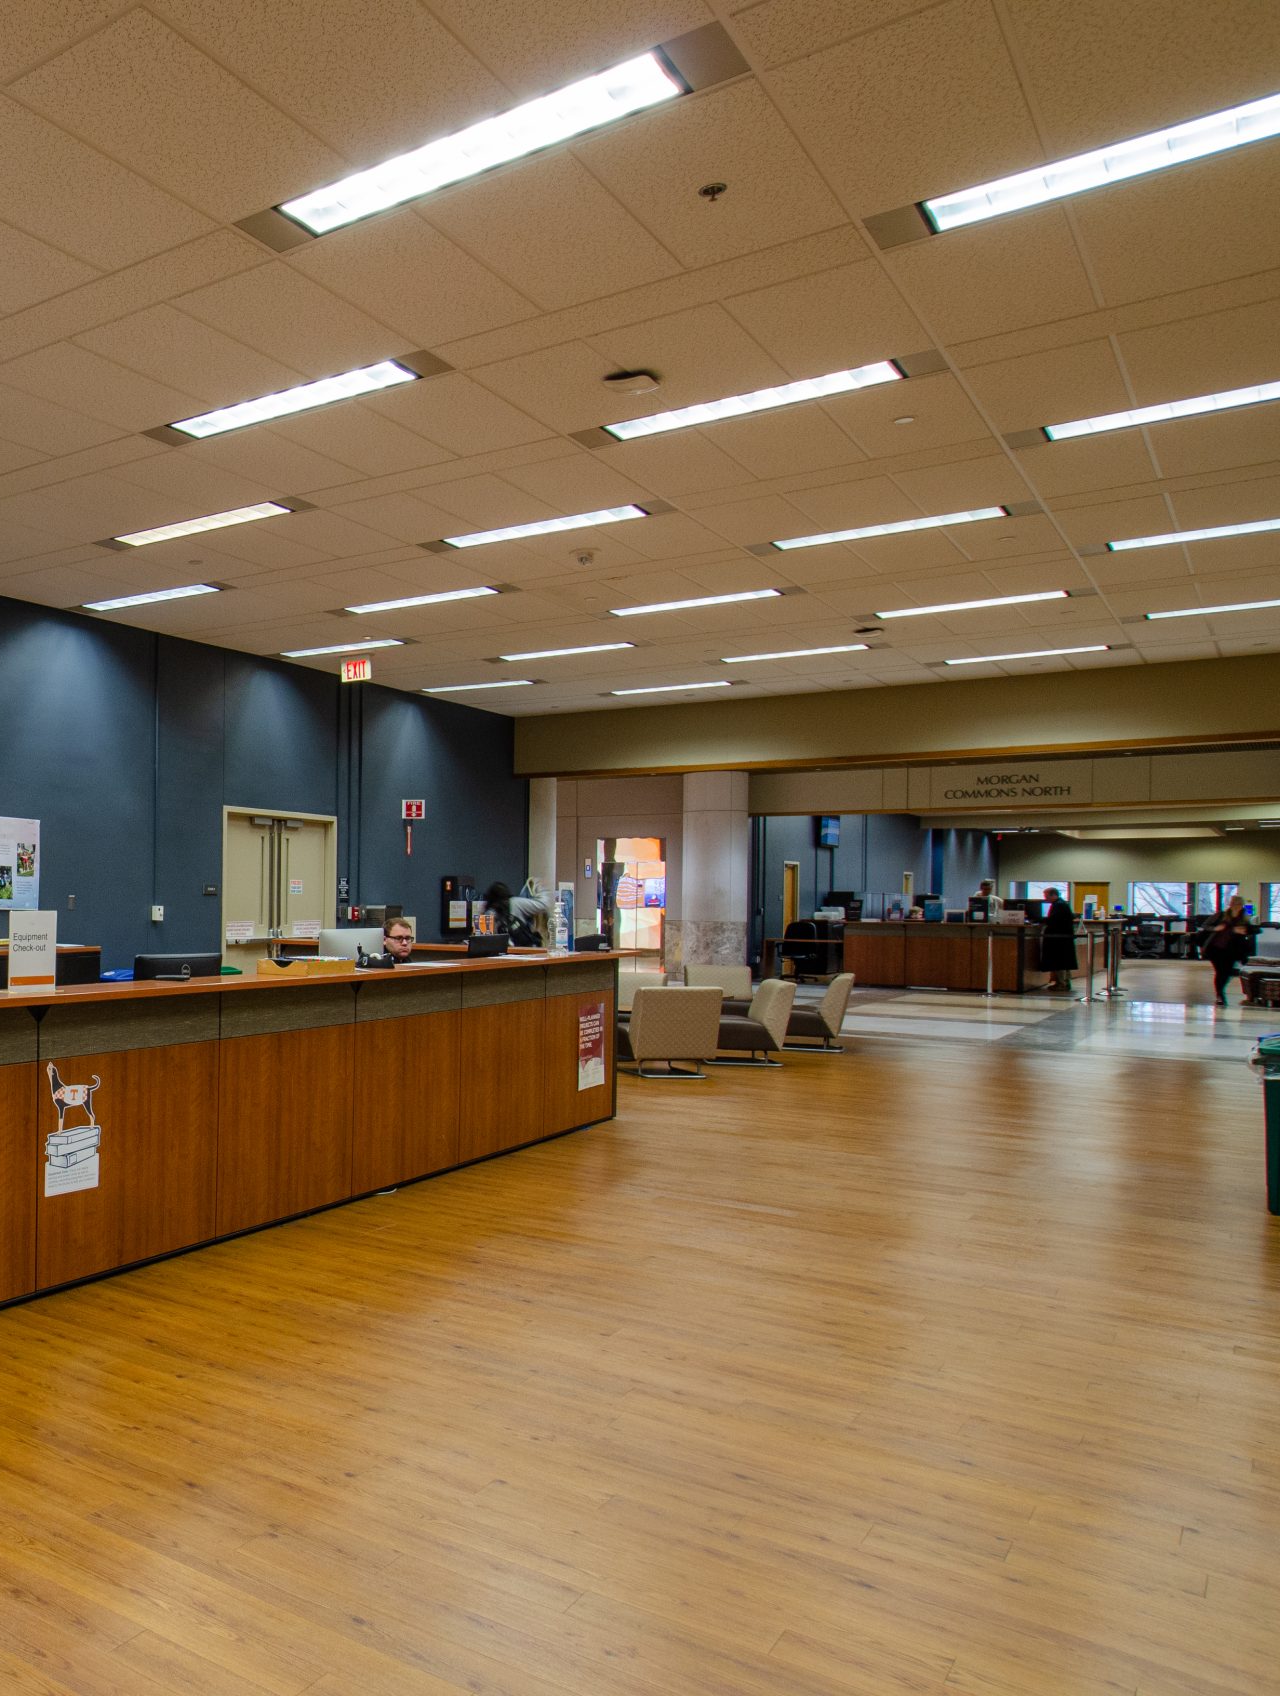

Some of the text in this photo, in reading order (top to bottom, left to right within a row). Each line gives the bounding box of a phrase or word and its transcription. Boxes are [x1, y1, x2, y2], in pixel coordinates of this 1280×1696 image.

[346, 659, 366, 680] EXIT
[976, 773, 1039, 786] MORGAN
[944, 785, 1071, 800] COMMONS NORTH
[13, 932, 48, 942] Equipment
[12, 944, 46, 952] Check-out
[70, 1089, 78, 1100] T
